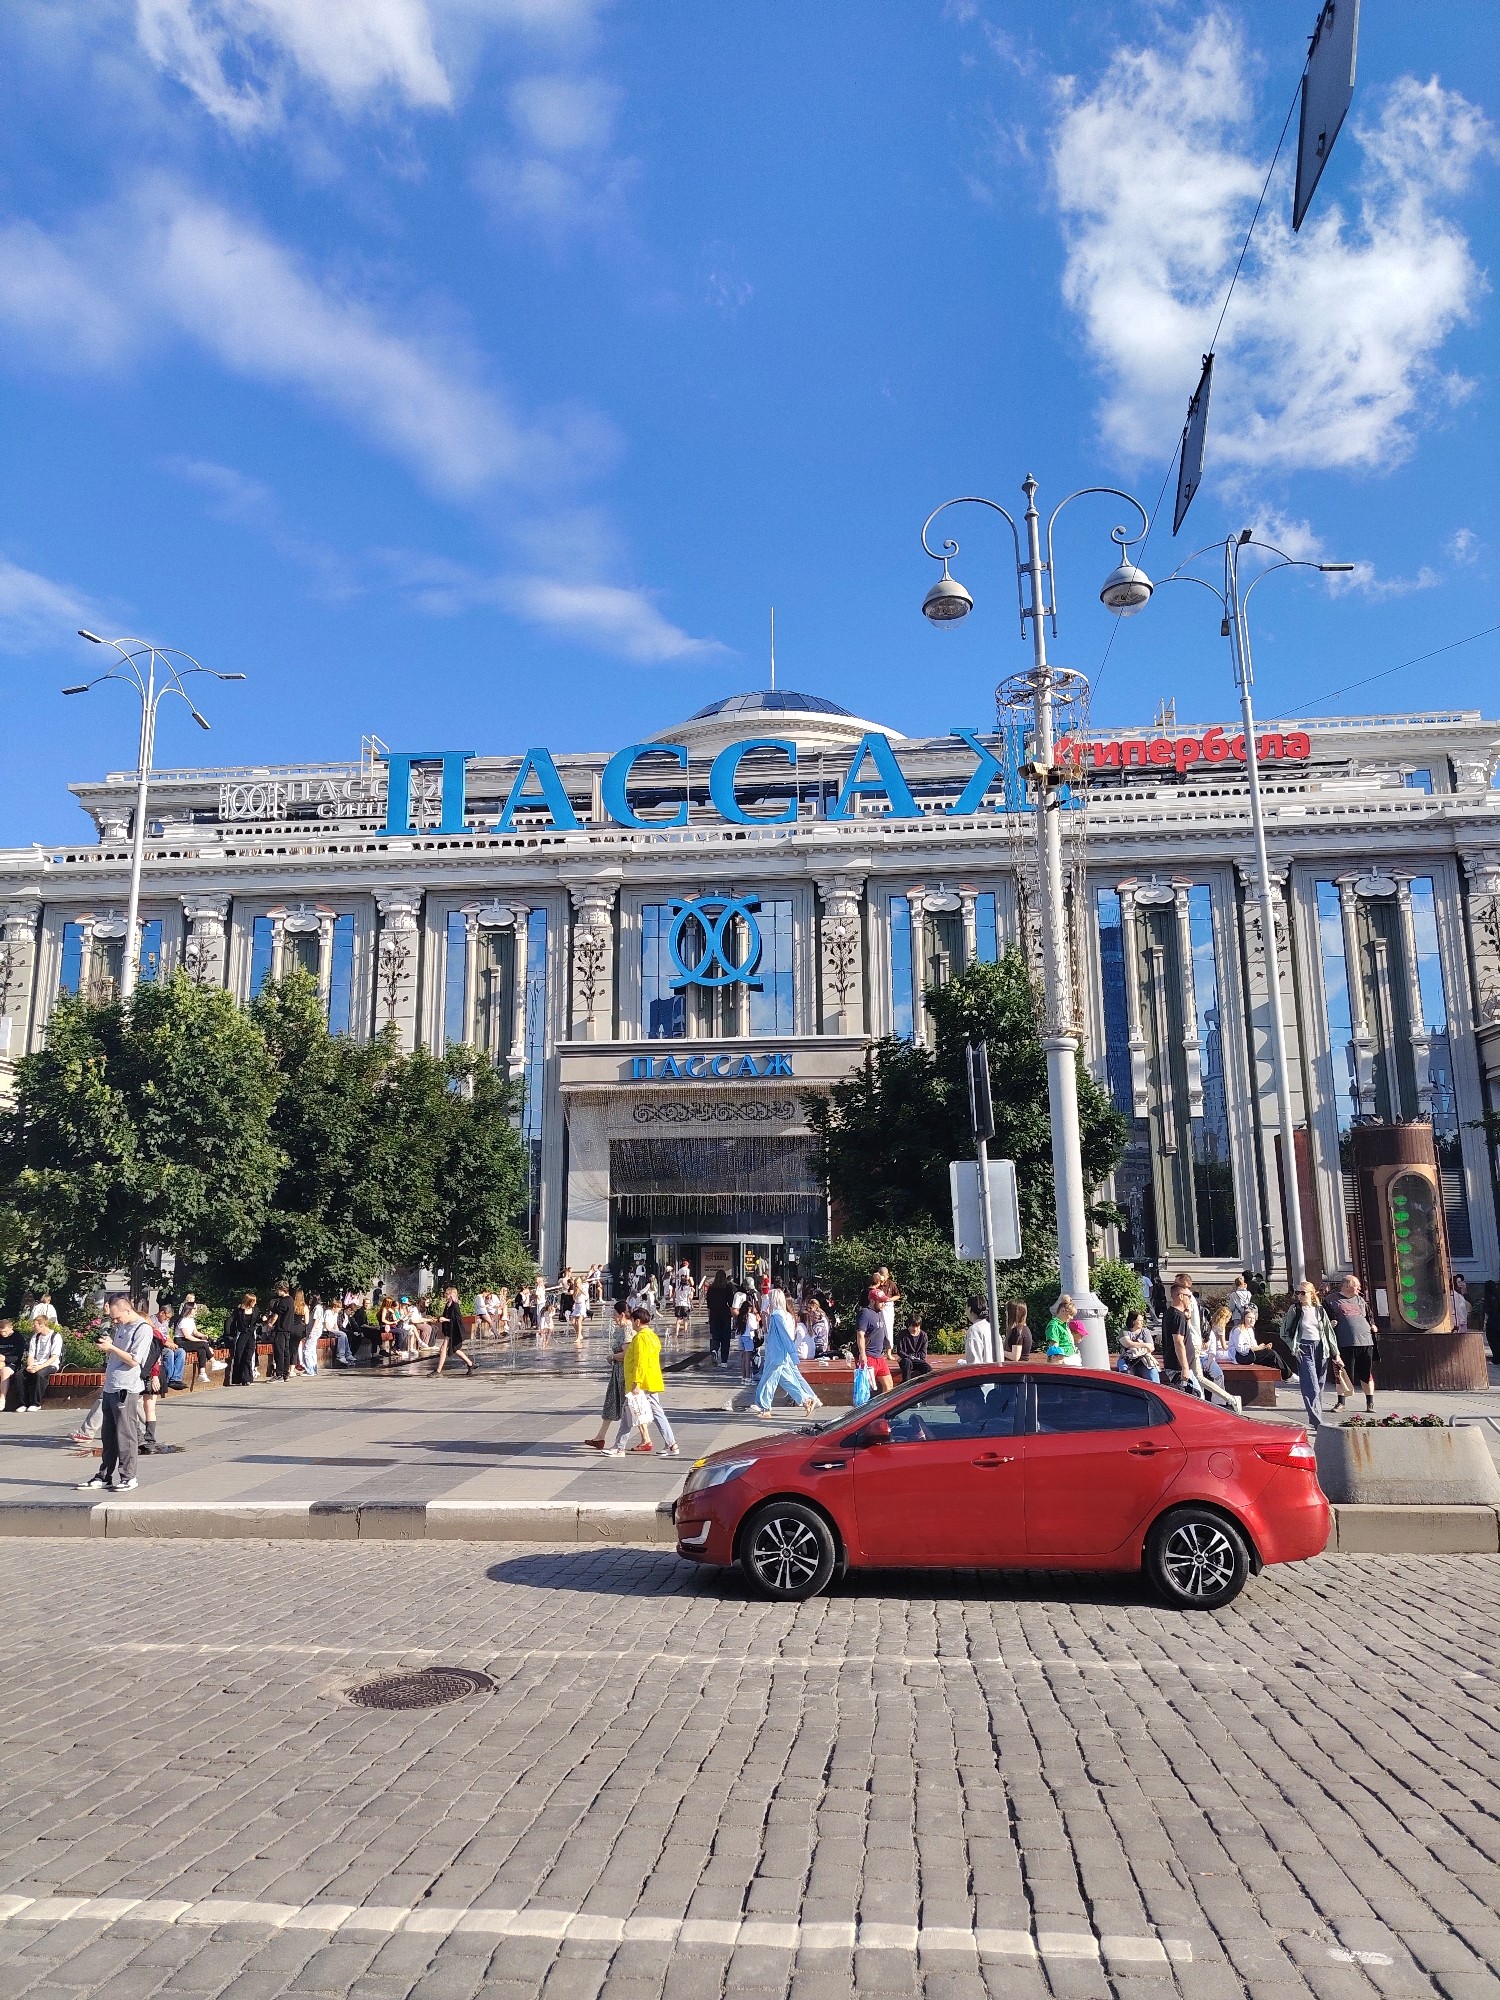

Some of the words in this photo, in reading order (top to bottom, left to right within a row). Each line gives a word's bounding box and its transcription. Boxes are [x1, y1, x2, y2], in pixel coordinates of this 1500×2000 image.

[375, 721, 1087, 836] ПАССАЖ
[316, 800, 435, 818] СИНЕА
[631, 1053, 795, 1079] ПАССАЖ
